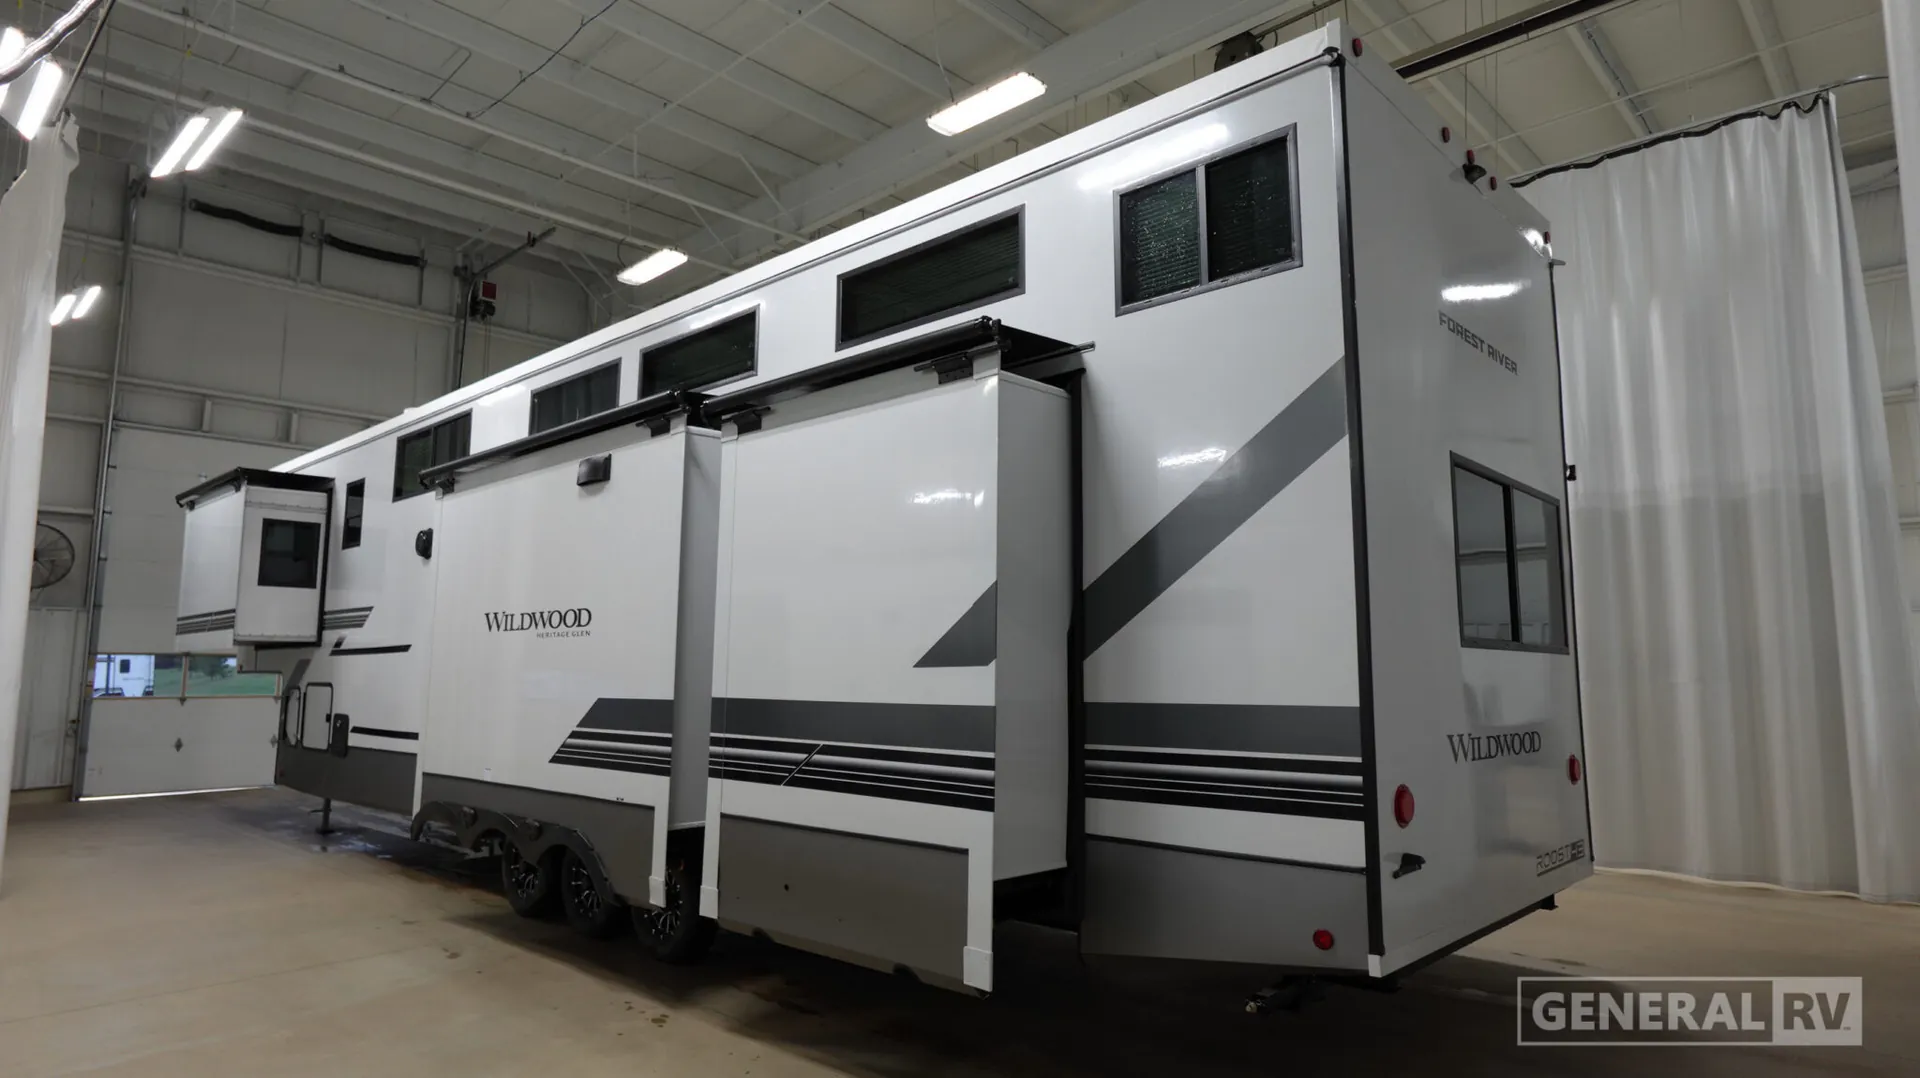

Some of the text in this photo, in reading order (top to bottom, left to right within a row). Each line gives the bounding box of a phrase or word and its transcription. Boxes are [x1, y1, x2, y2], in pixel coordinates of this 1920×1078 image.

[1438, 309, 1519, 376] FOREST RIVER
[484, 607, 592, 632] WILDWOOD
[536, 631, 570, 639] HERITAGE
[1446, 730, 1542, 764] WILDWOOD
